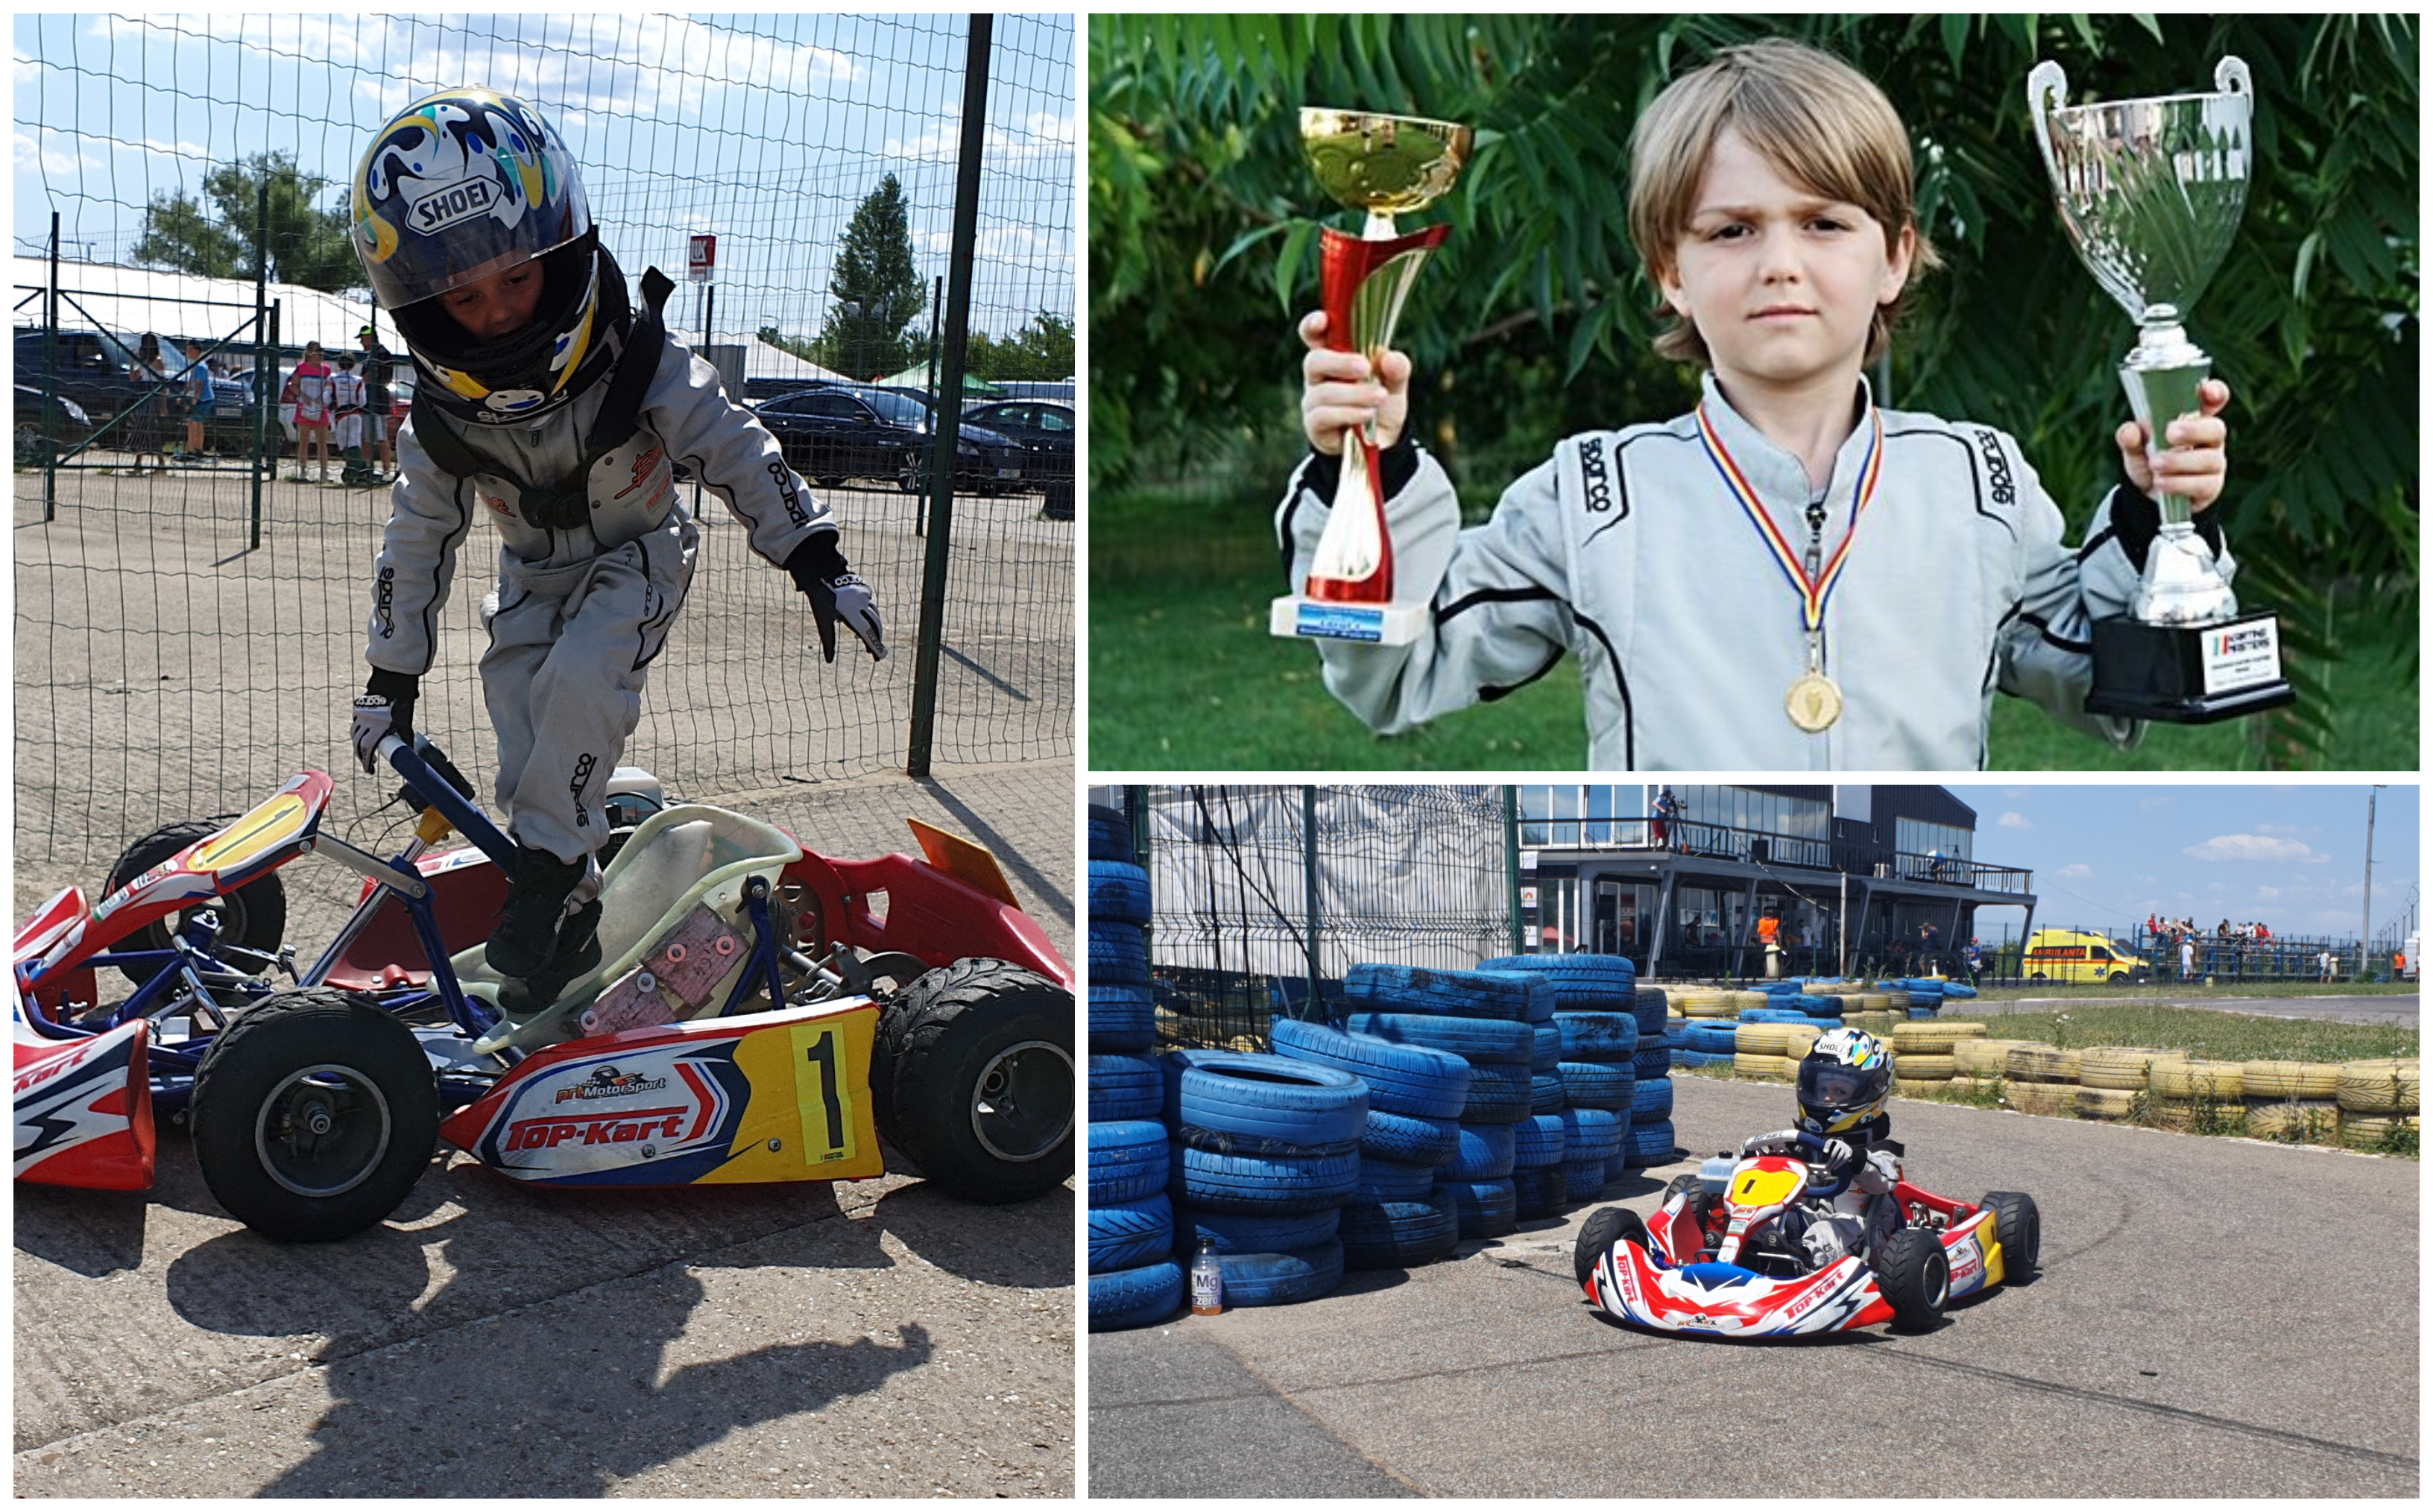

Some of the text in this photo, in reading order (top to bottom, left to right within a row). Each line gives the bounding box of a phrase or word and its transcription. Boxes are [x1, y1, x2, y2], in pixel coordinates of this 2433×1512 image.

[418, 181, 490, 227] SHOEI
[1580, 437, 1611, 513] sparco
[807, 1031, 844, 1149] 1
[504, 1106, 689, 1152] TOP-Kart
[1196, 1274, 1218, 1291] Mg
[1196, 1296, 1218, 1306] zero
[1783, 1268, 1845, 1320] TOP-Kart
